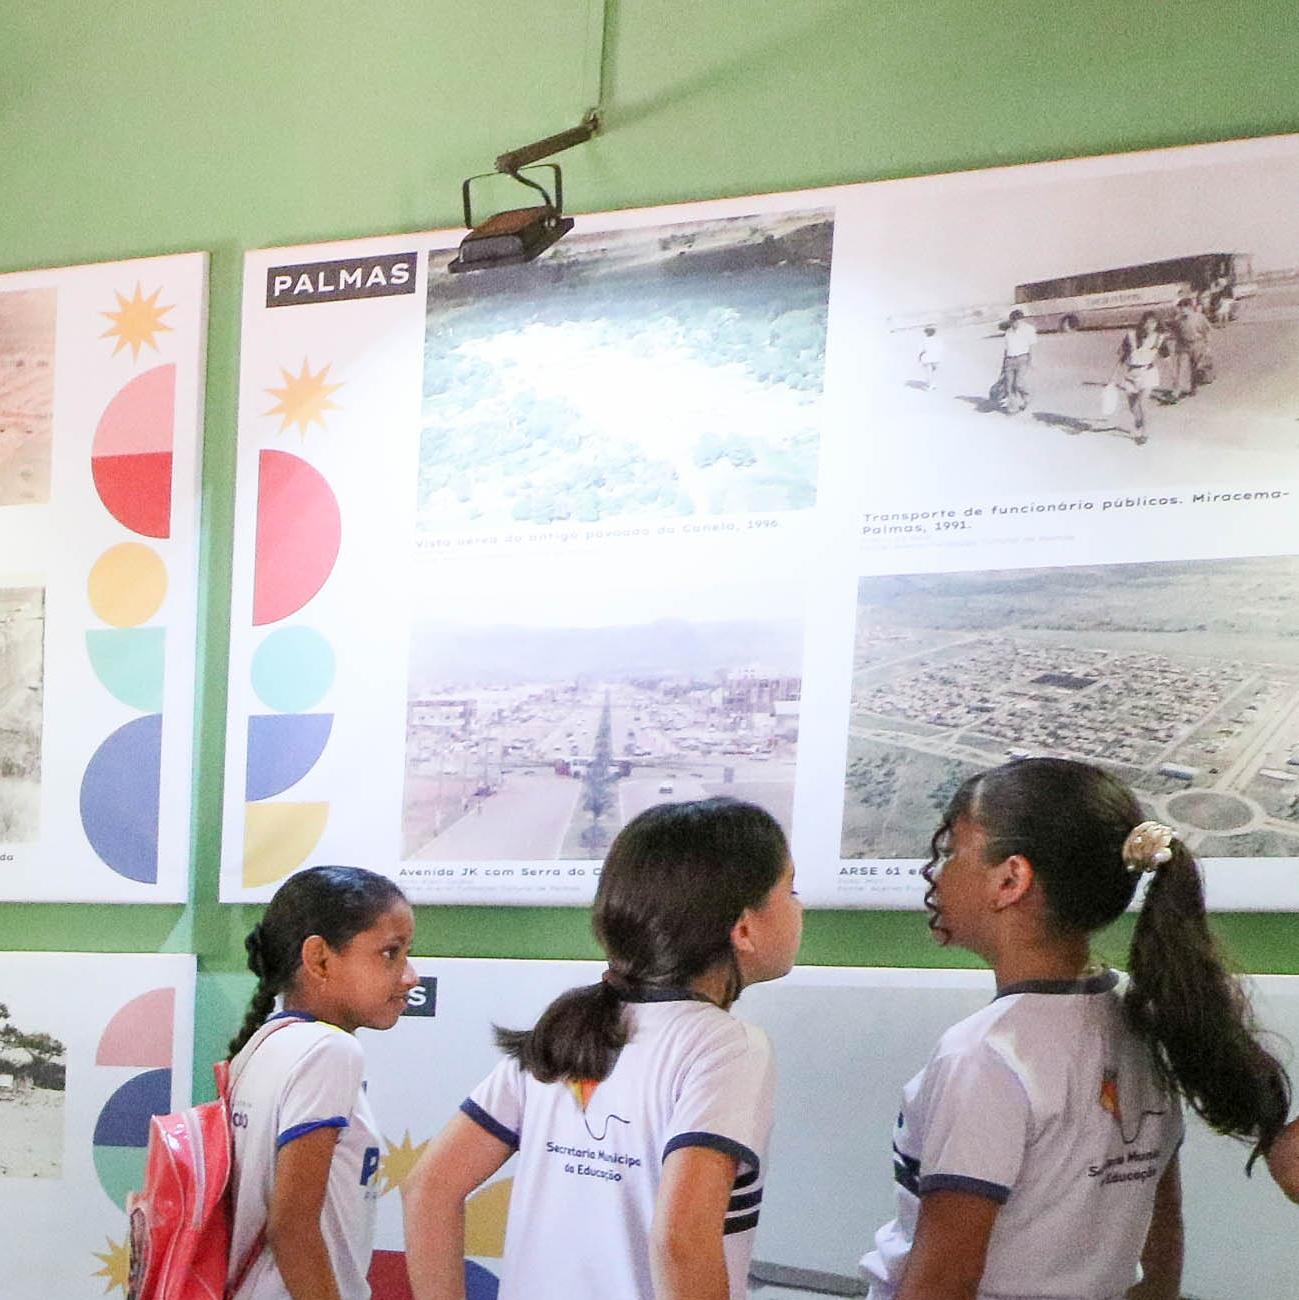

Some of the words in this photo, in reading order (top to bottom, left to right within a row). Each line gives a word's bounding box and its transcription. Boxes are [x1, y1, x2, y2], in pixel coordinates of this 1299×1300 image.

[274, 262, 410, 297] PALMAS
[864, 508, 956, 523] Transporte
[964, 505, 983, 516] de
[992, 501, 1093, 516] funcionário
[1102, 494, 1183, 511] públicos.
[1192, 491, 1290, 504] Miracema-
[863, 524, 927, 536] Palmas,
[935, 520, 971, 531] 1991.
[399, 868, 454, 876] Avenida
[461, 868, 478, 876] JK
[521, 868, 561, 876] Serra
[568, 868, 585, 876] do
[840, 866, 878, 875] ARSE
[885, 866, 900, 875] 61
